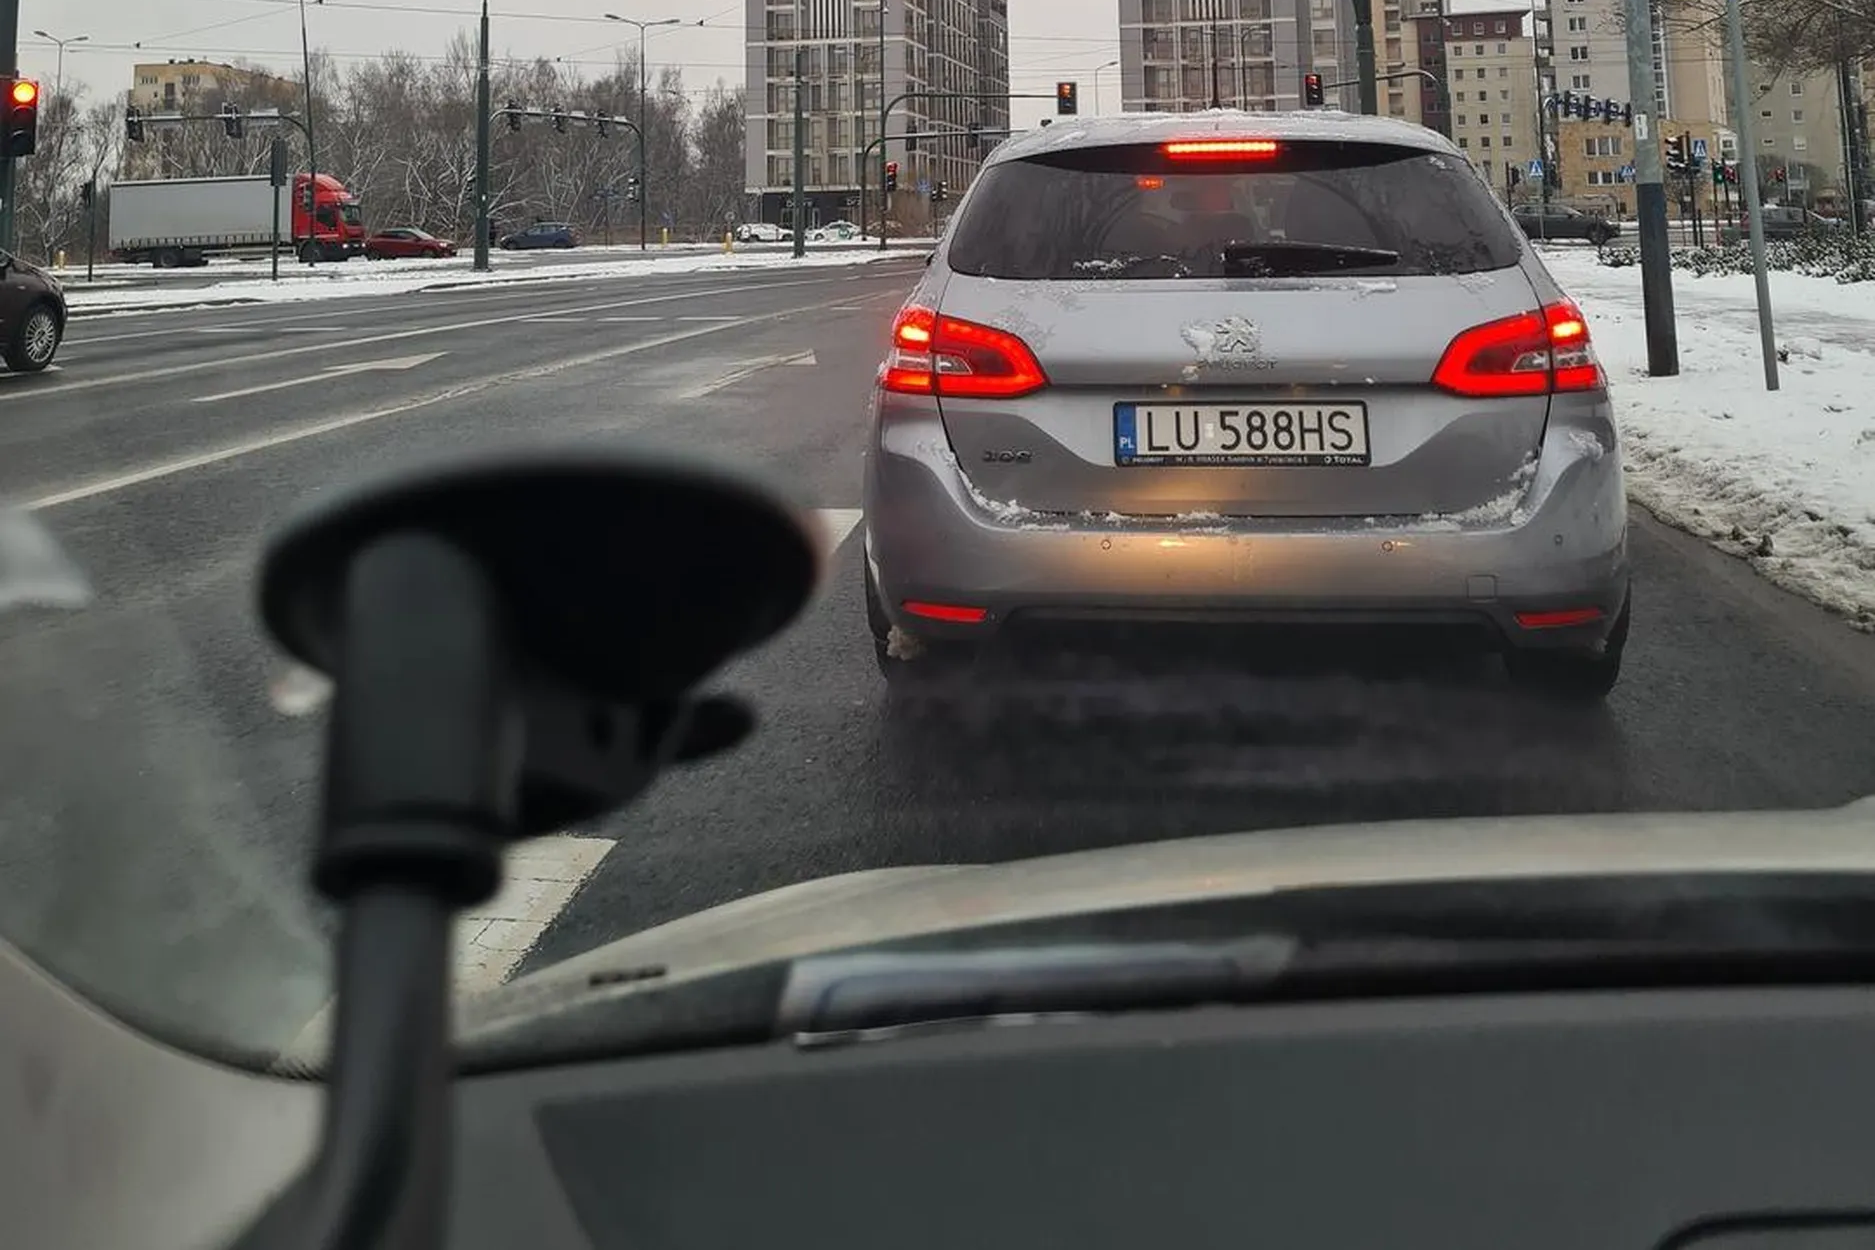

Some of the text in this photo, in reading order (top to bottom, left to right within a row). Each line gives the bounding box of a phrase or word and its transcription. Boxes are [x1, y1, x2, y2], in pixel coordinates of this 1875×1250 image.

[1119, 436, 1135, 449] PL
[1146, 410, 1353, 451] LU 588HS
